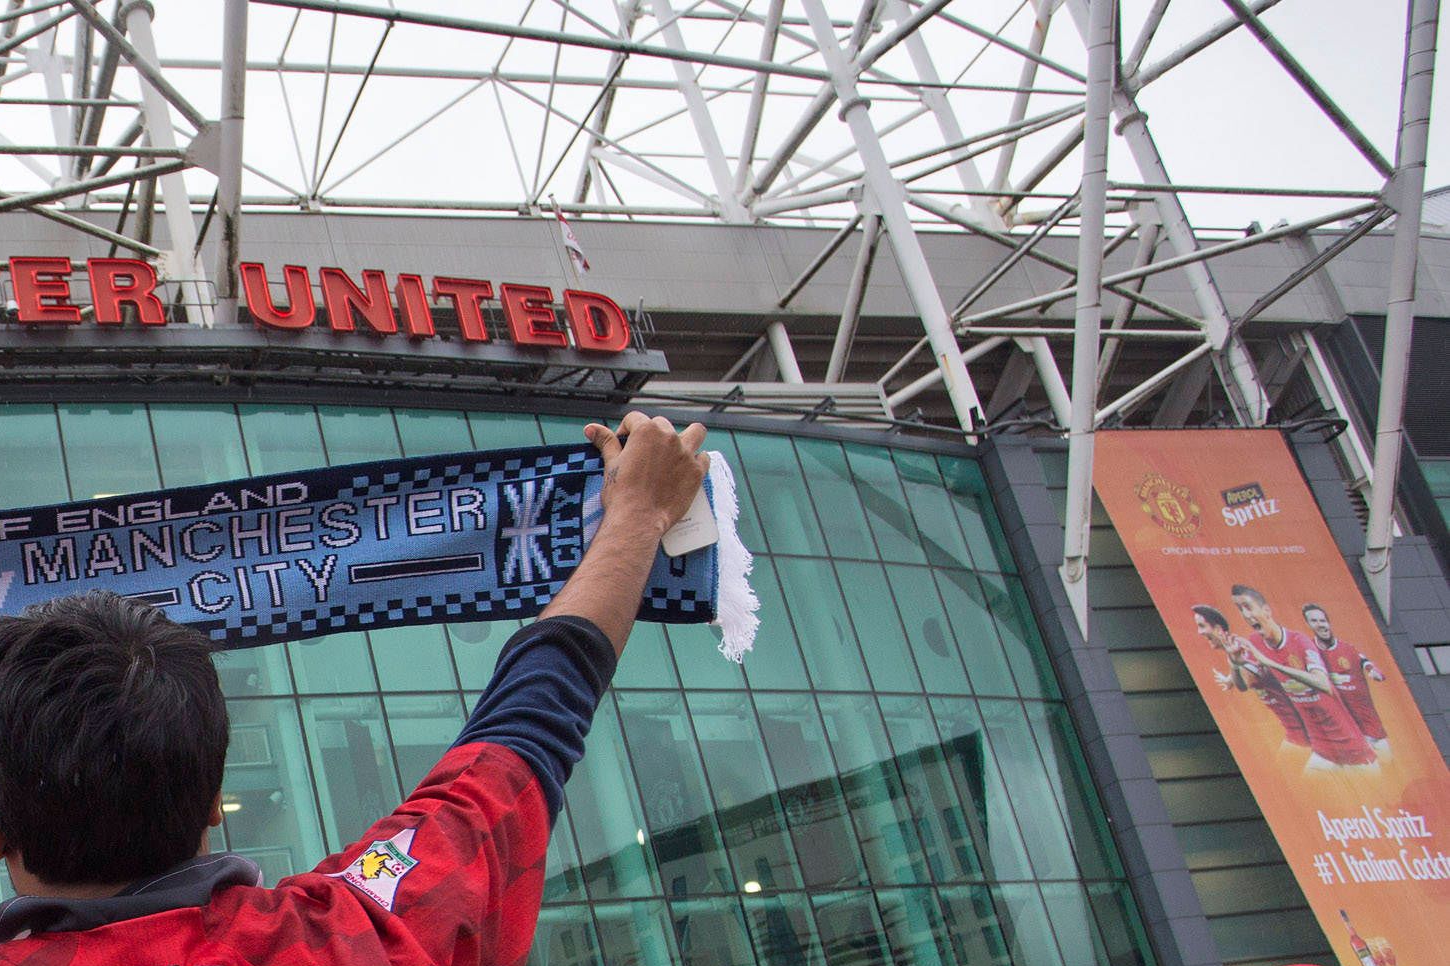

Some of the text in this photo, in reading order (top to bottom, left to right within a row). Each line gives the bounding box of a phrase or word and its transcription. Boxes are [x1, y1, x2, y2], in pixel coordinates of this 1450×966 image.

[239, 261, 631, 353] UNITED
[56, 482, 308, 531] ENGLAND
[551, 486, 582, 567] CITY
[1221, 498, 1280, 527] Spritz
[22, 485, 487, 587] MANCHESTER
[187, 554, 339, 616] CITY
[1317, 805, 1432, 848] Aperol Spritz
[1313, 846, 1450, 884] #1 Italian Cockt
